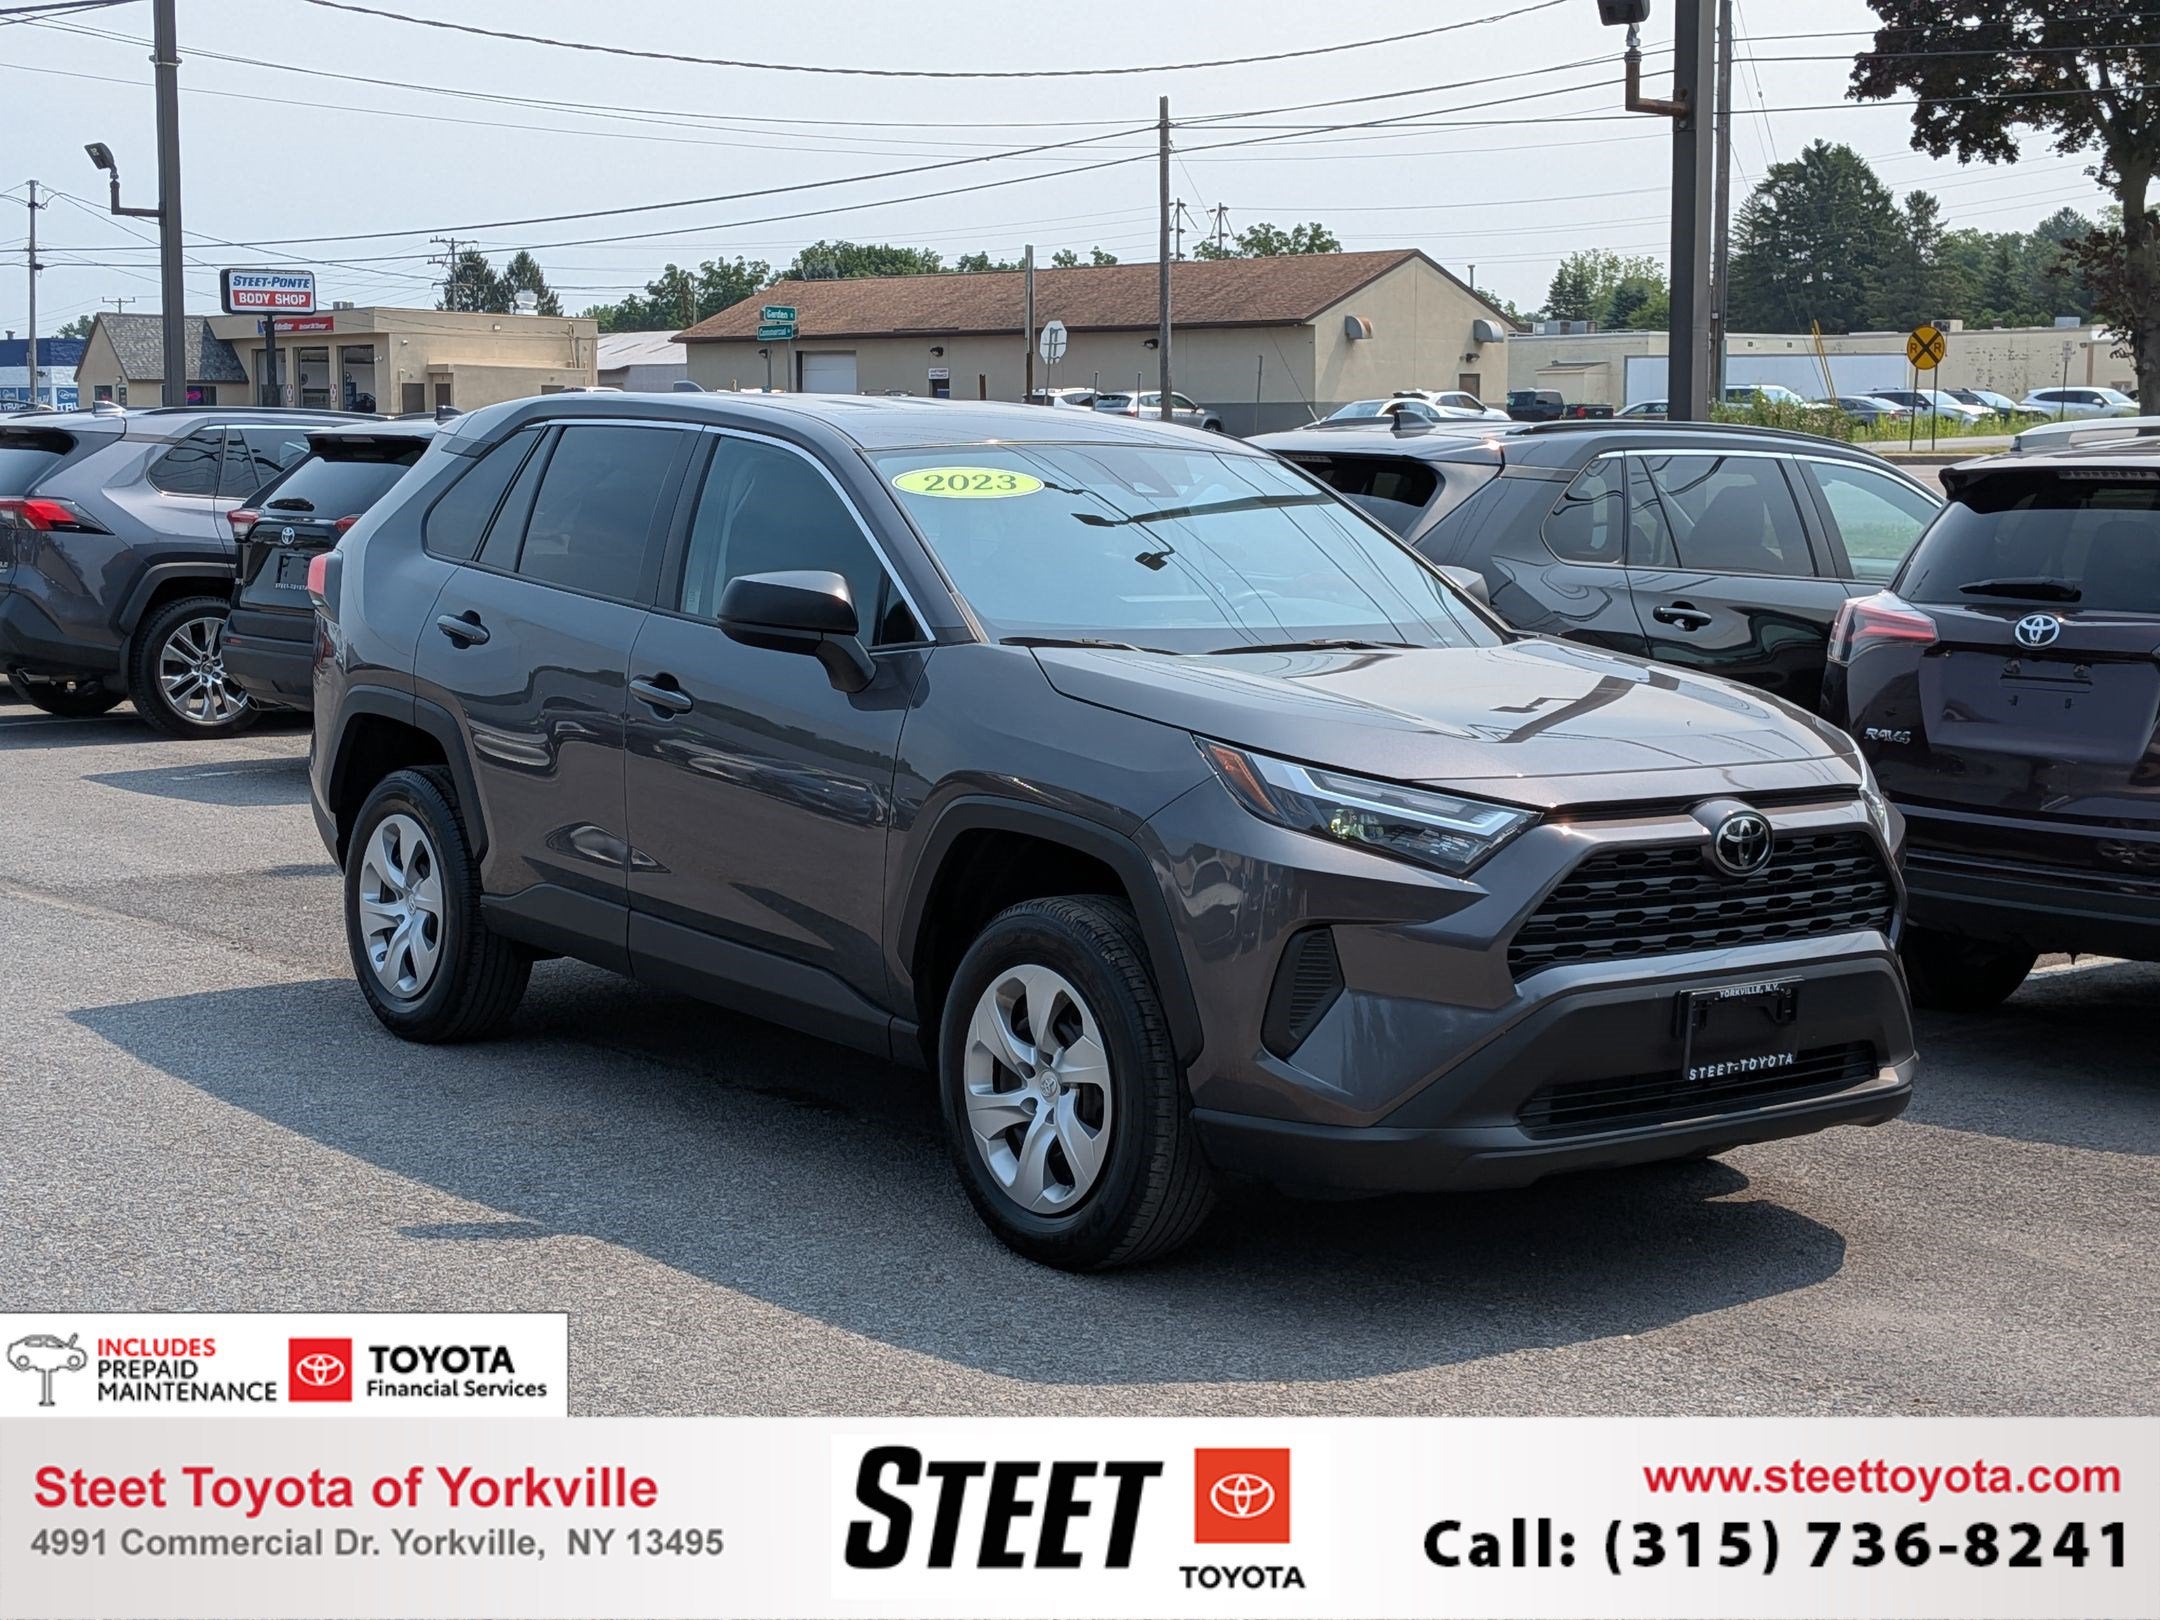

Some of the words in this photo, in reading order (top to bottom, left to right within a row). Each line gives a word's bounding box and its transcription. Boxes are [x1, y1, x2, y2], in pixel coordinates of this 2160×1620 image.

[233, 275, 311, 289] STEET-PONTE
[239, 292, 271, 304] BODY
[275, 294, 306, 305] SHOP
[923, 474, 1017, 491] 2023
